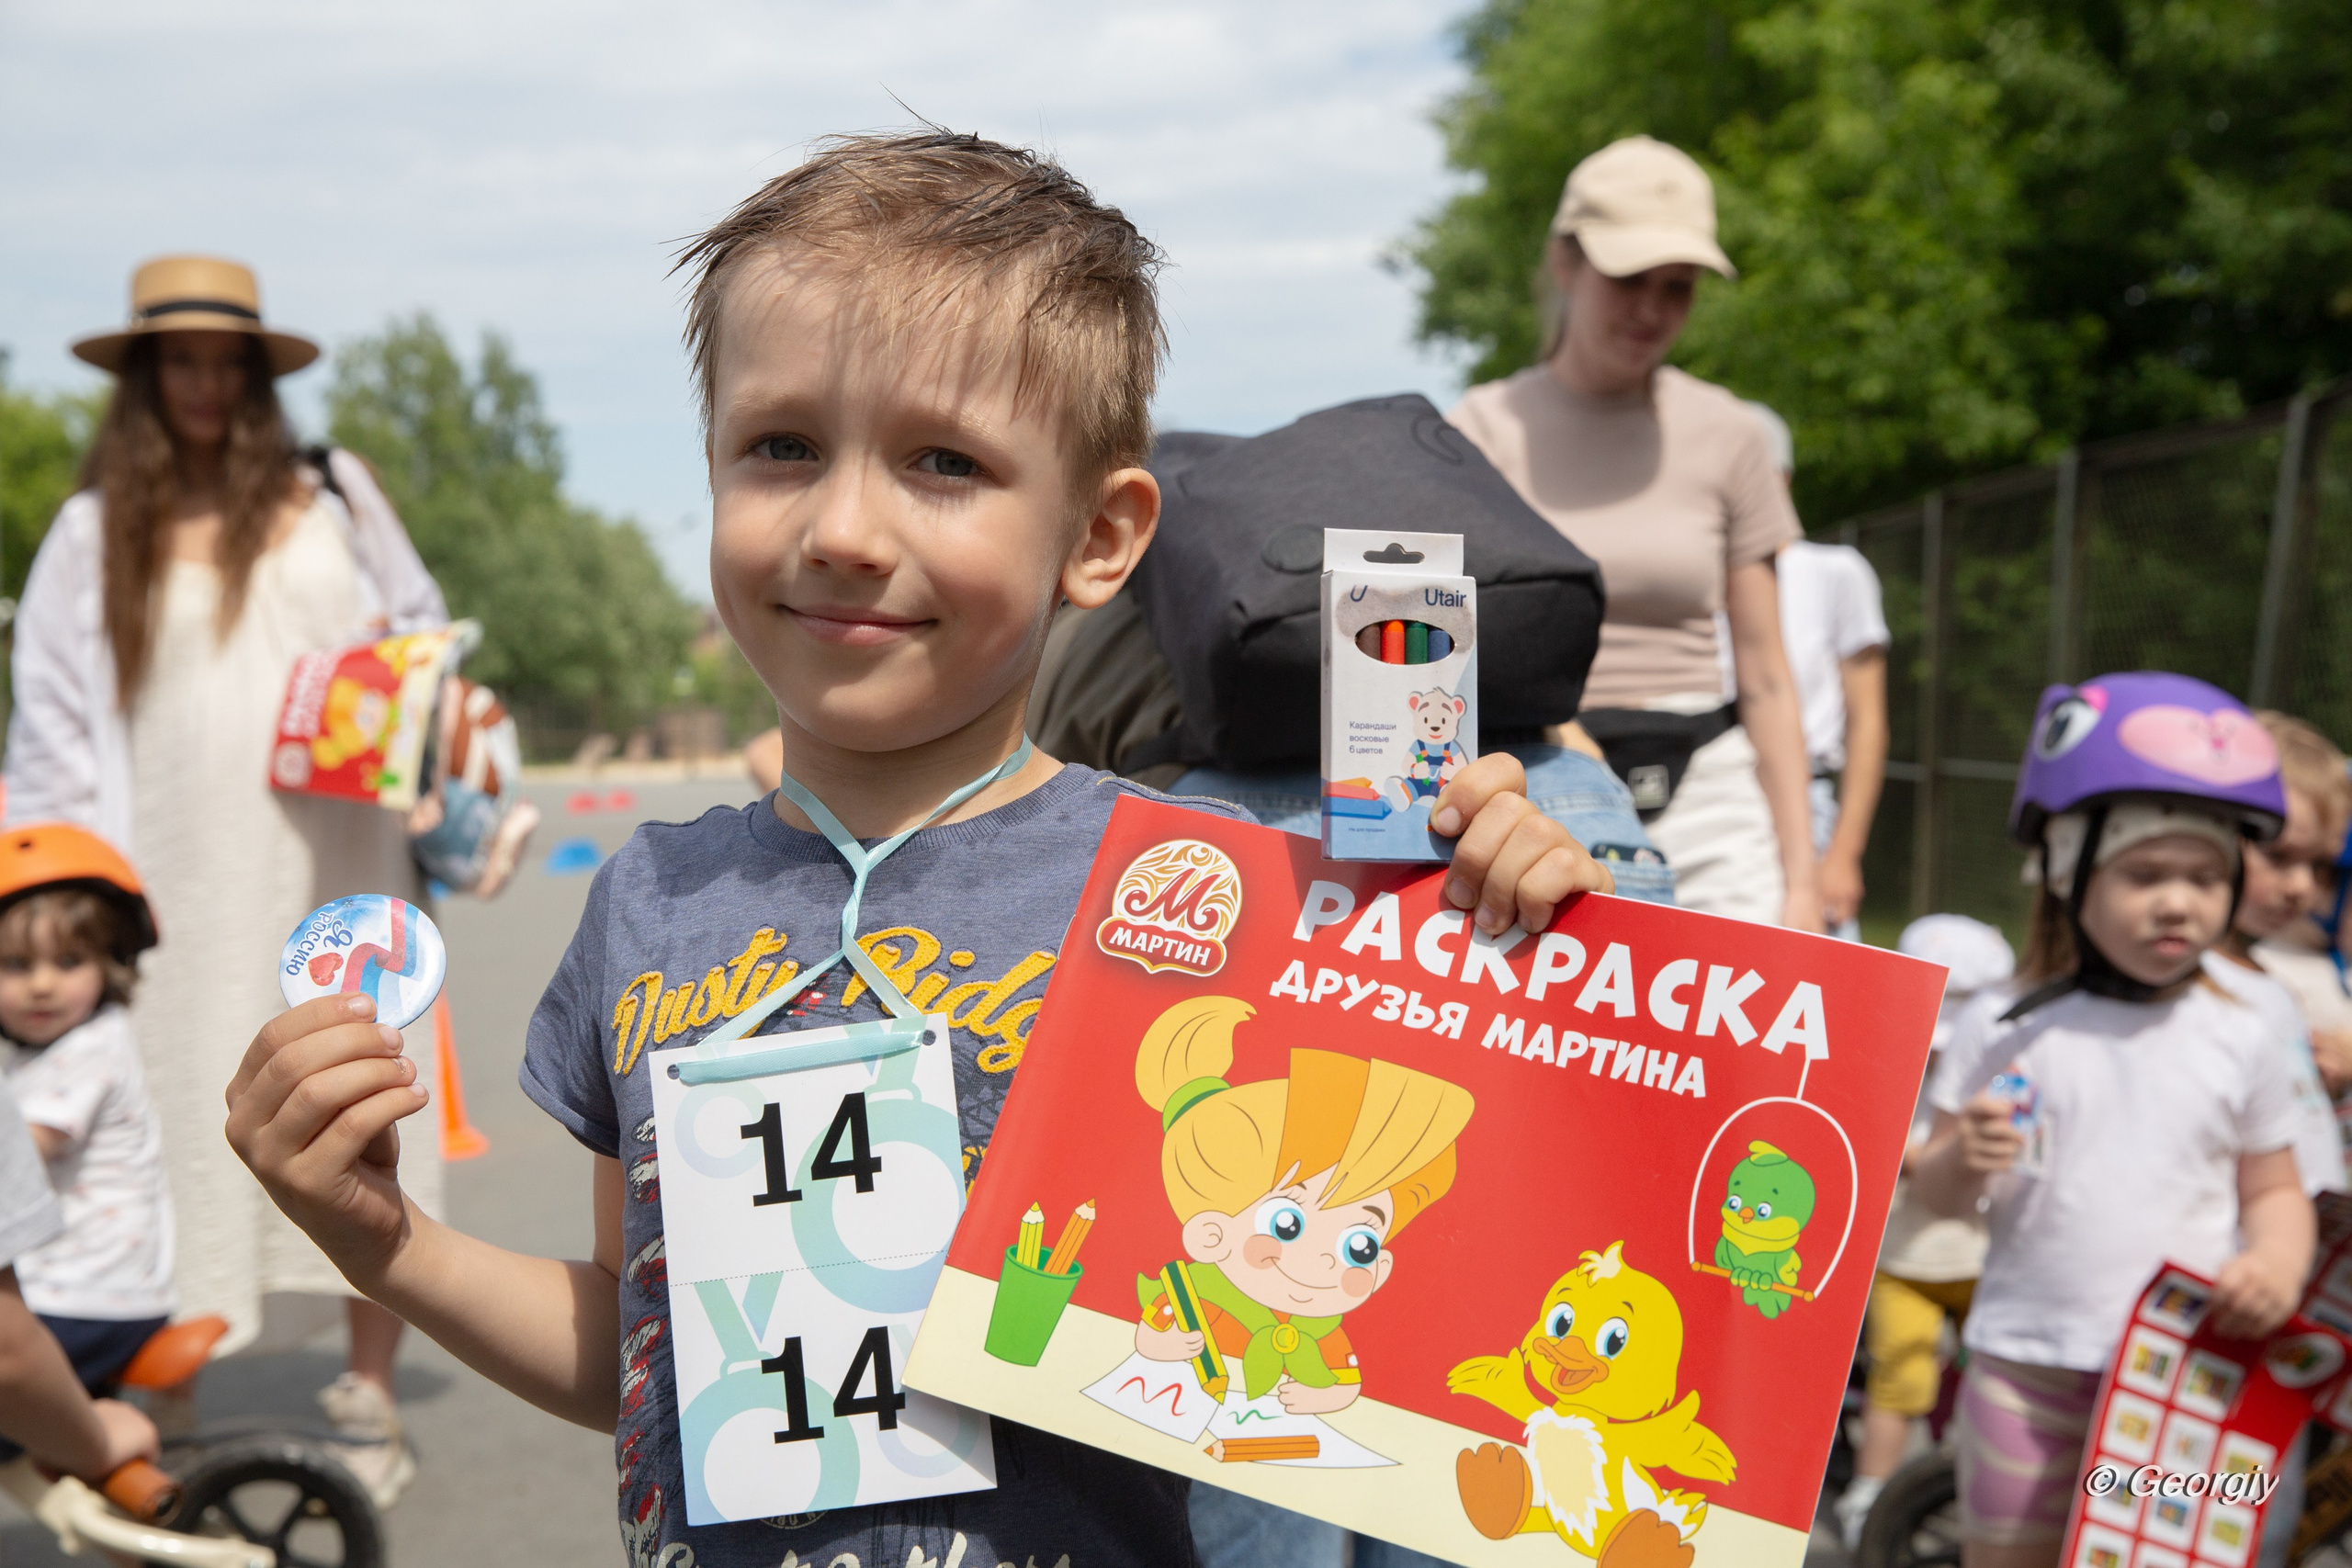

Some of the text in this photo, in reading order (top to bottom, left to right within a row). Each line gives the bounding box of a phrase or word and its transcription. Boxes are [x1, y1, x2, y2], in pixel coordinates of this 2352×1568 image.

[1425, 588, 1466, 607] Utair
[1350, 721, 1396, 731] Карандаши
[1350, 735, 1389, 743] восковые
[1350, 745, 1355, 753] 6
[286, 912, 334, 976] РОССИЮ
[322, 919, 354, 949] Я
[1109, 926, 1211, 965] МАРТИН
[1293, 880, 1829, 1060] РАСКРАСКА
[1269, 959, 1706, 1099] ДРУЗЬЯ МАРТИНА
[740, 1091, 883, 1207] 14
[761, 1325, 906, 1444] 14
